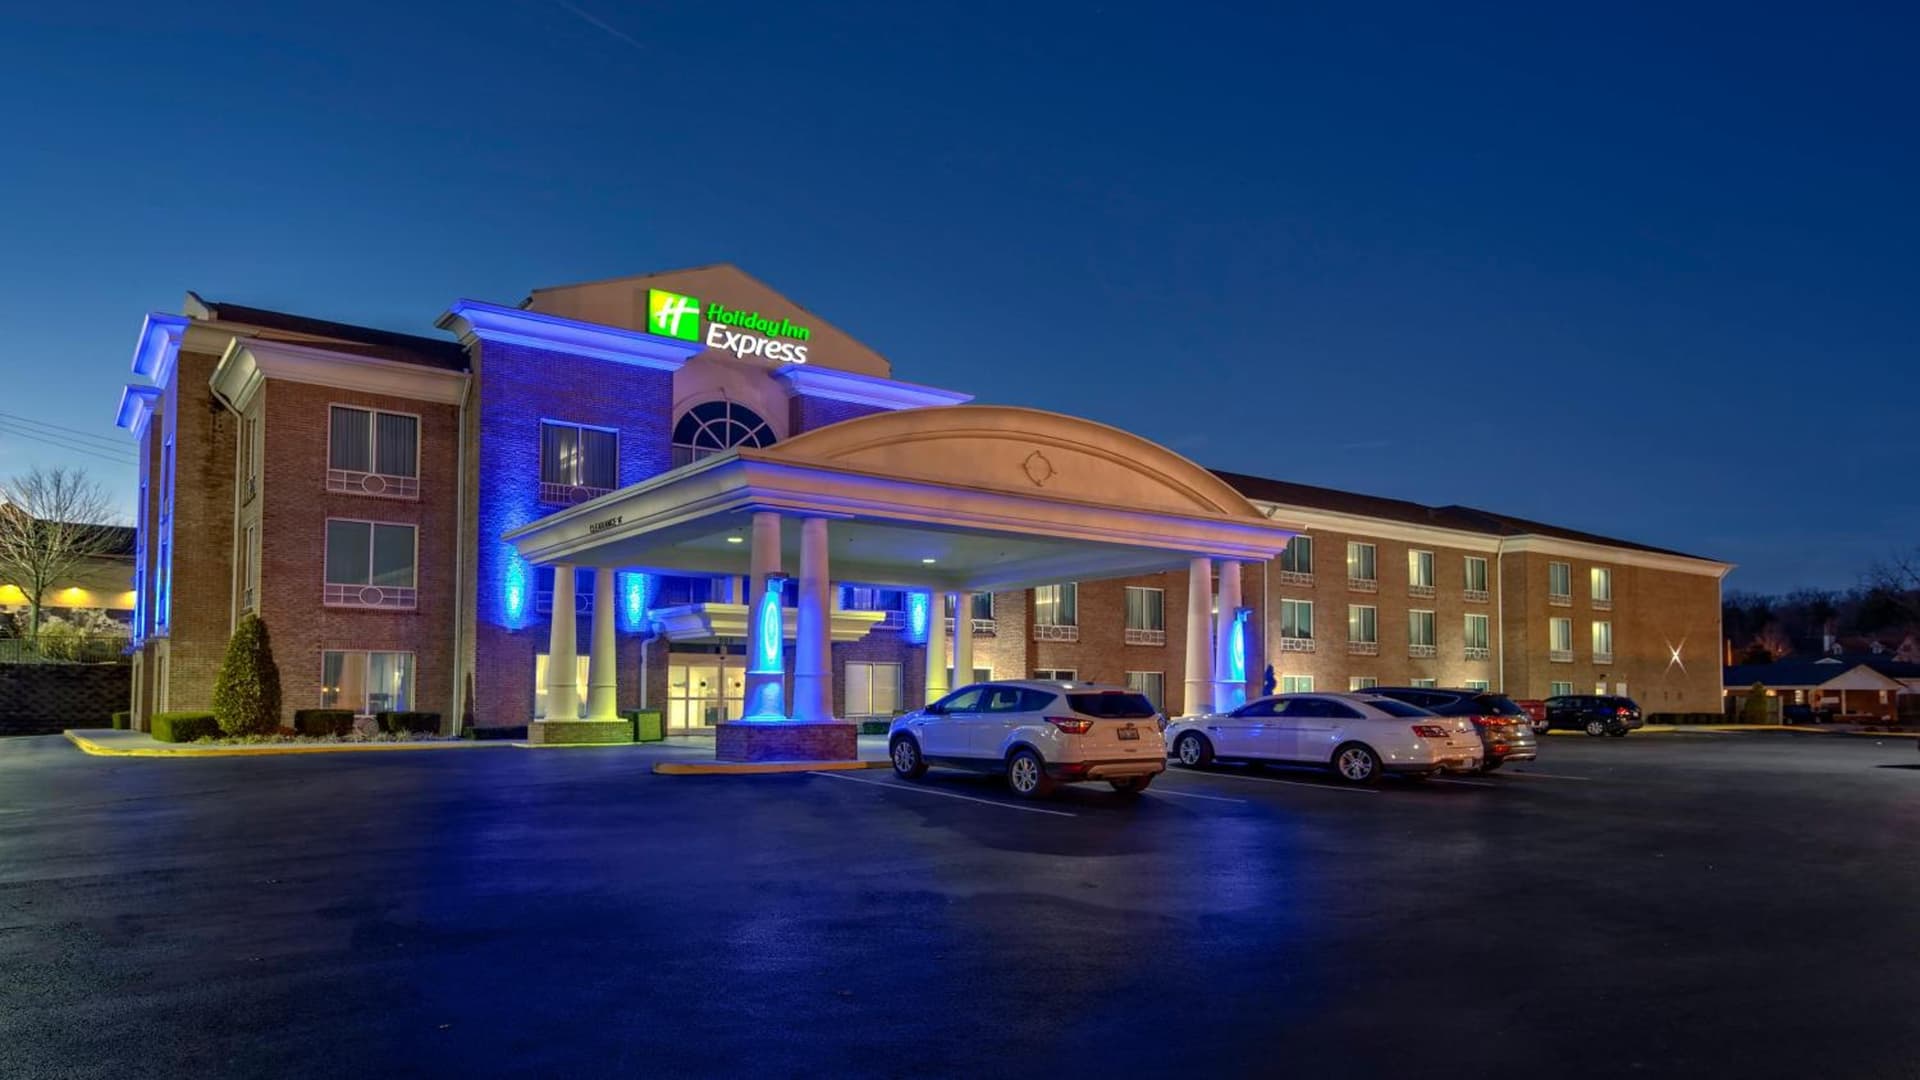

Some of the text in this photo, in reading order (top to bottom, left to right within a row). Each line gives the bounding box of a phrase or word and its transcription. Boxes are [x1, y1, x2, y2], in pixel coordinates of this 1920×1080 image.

[706, 303, 809, 341] Holiday Inn
[706, 322, 808, 363] Express
